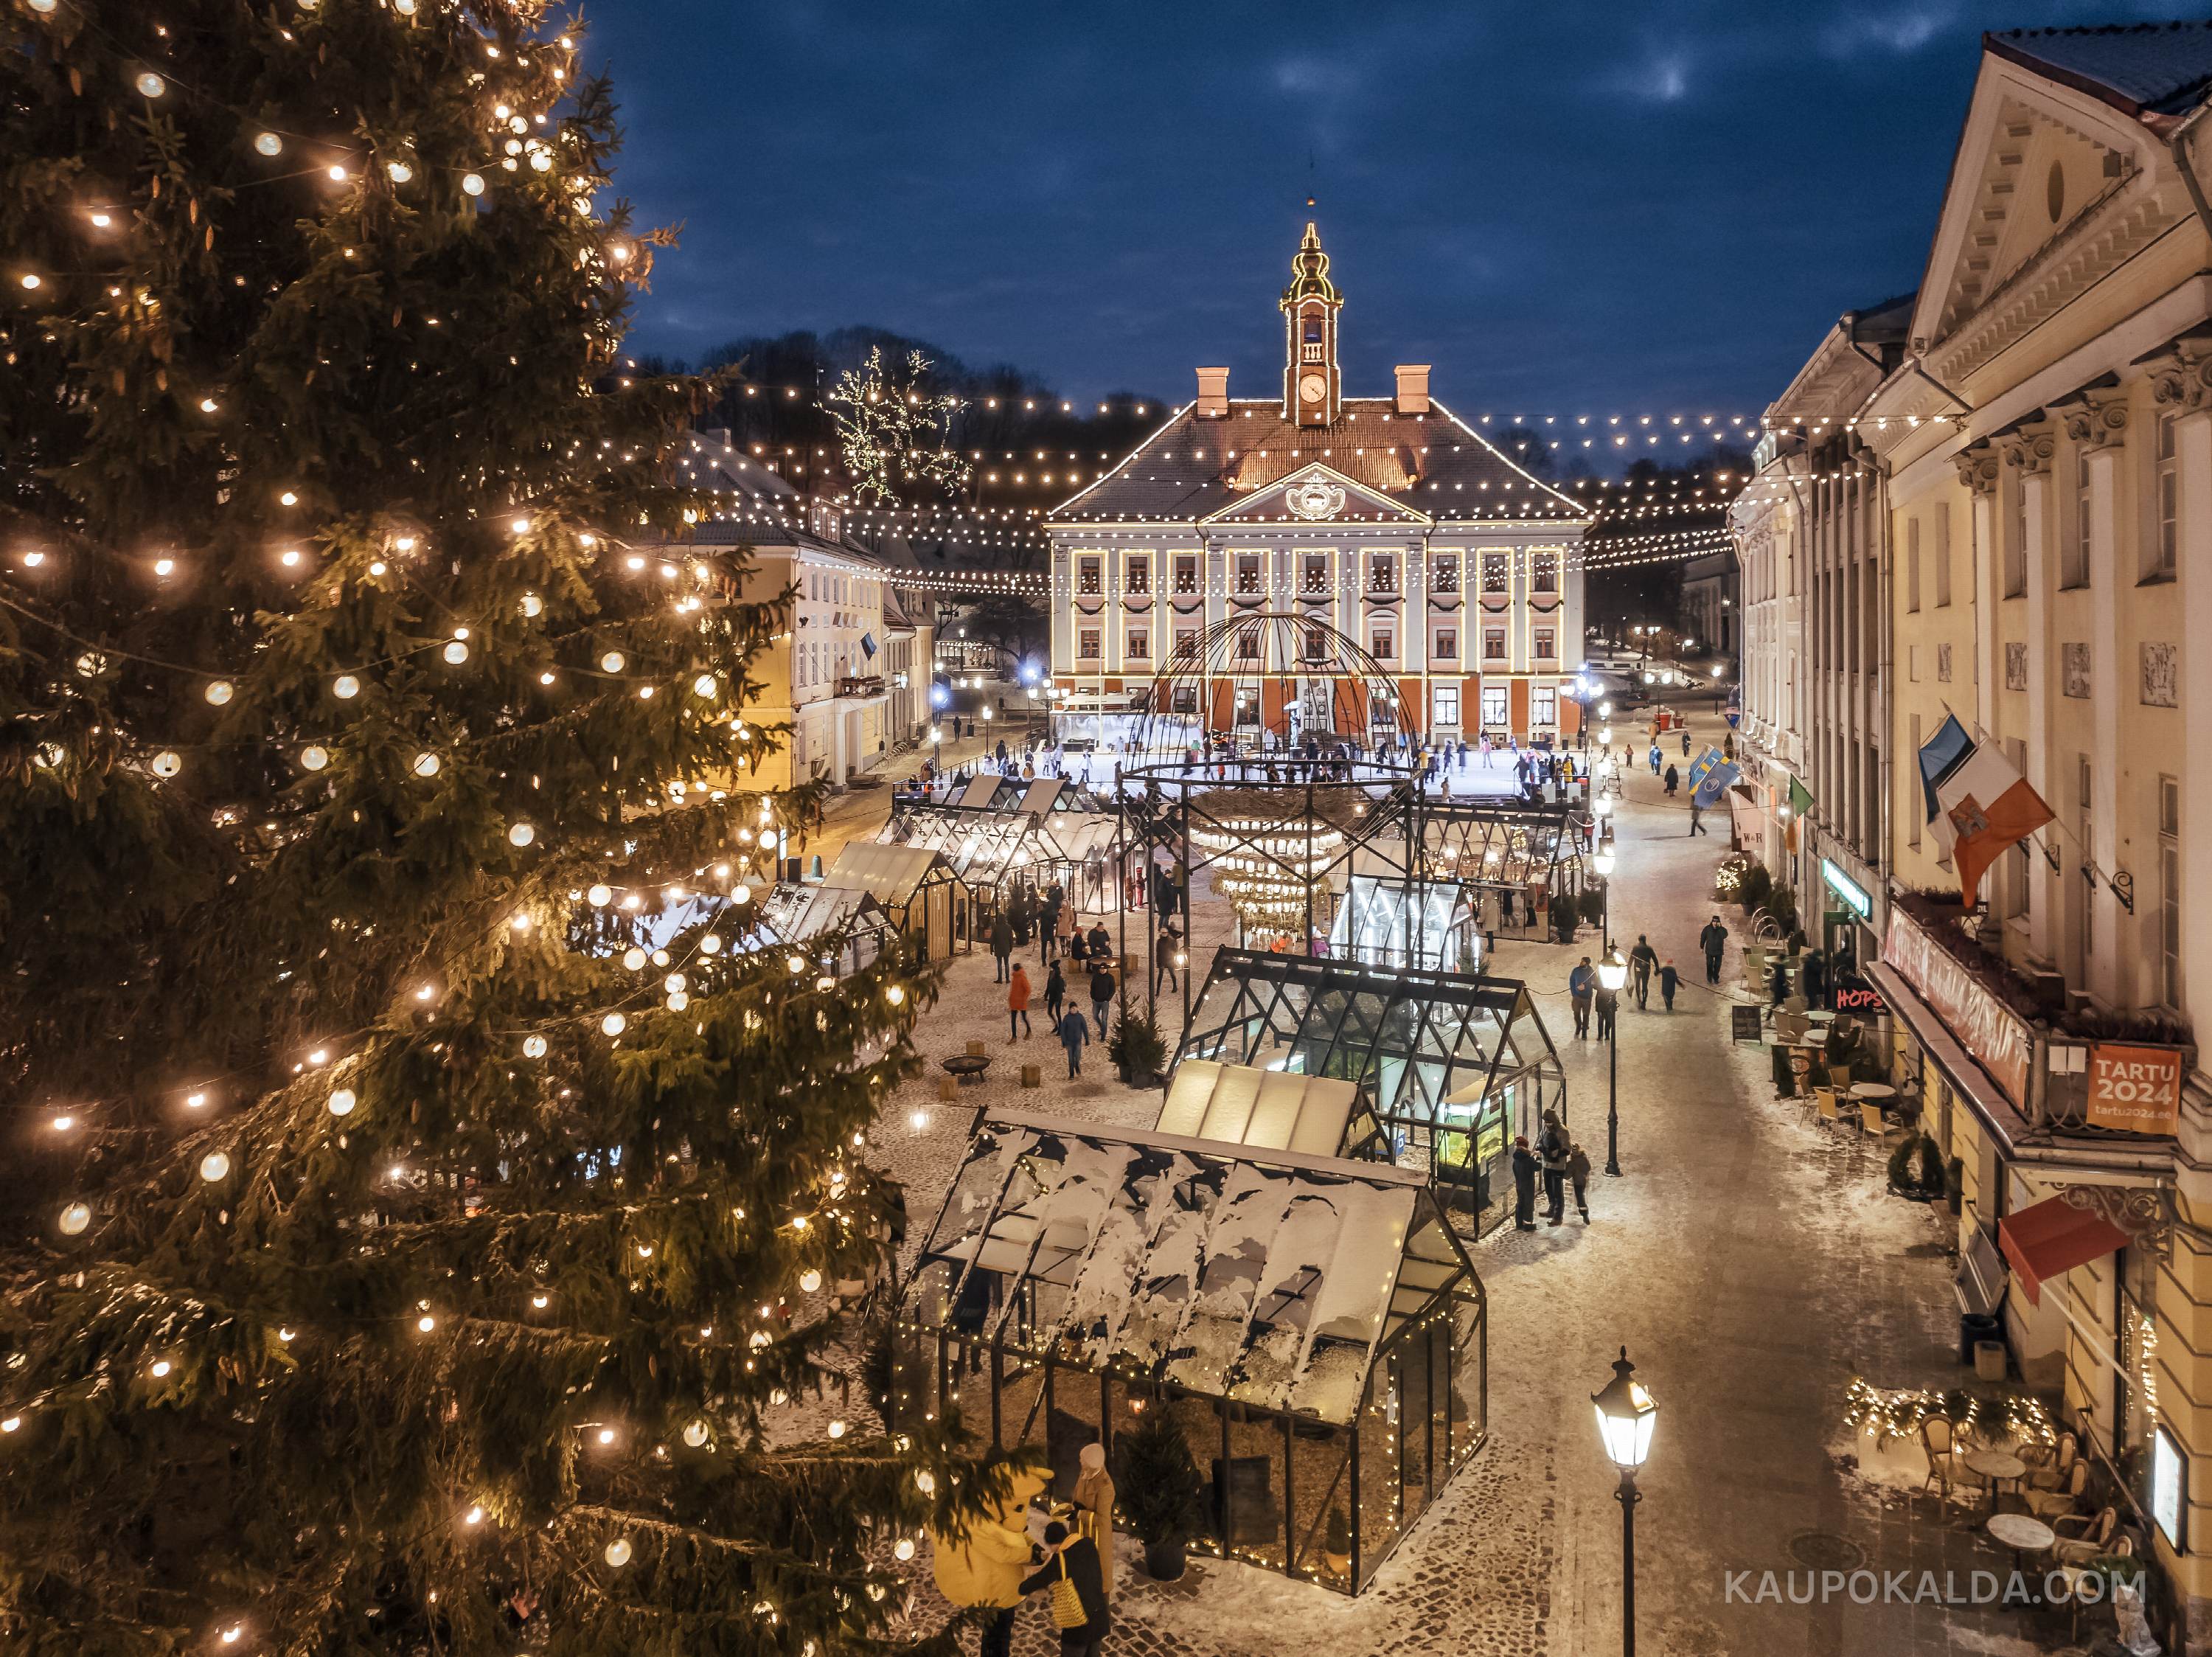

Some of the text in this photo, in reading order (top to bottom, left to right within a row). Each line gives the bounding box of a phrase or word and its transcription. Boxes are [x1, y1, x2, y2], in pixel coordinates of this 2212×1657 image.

[1837, 989, 1882, 1009] HOPS
[2096, 1059, 2174, 1082] TARTU
[2098, 1079, 2173, 1105] 2024
[2095, 1105, 2171, 1119] tartu2024.ee
